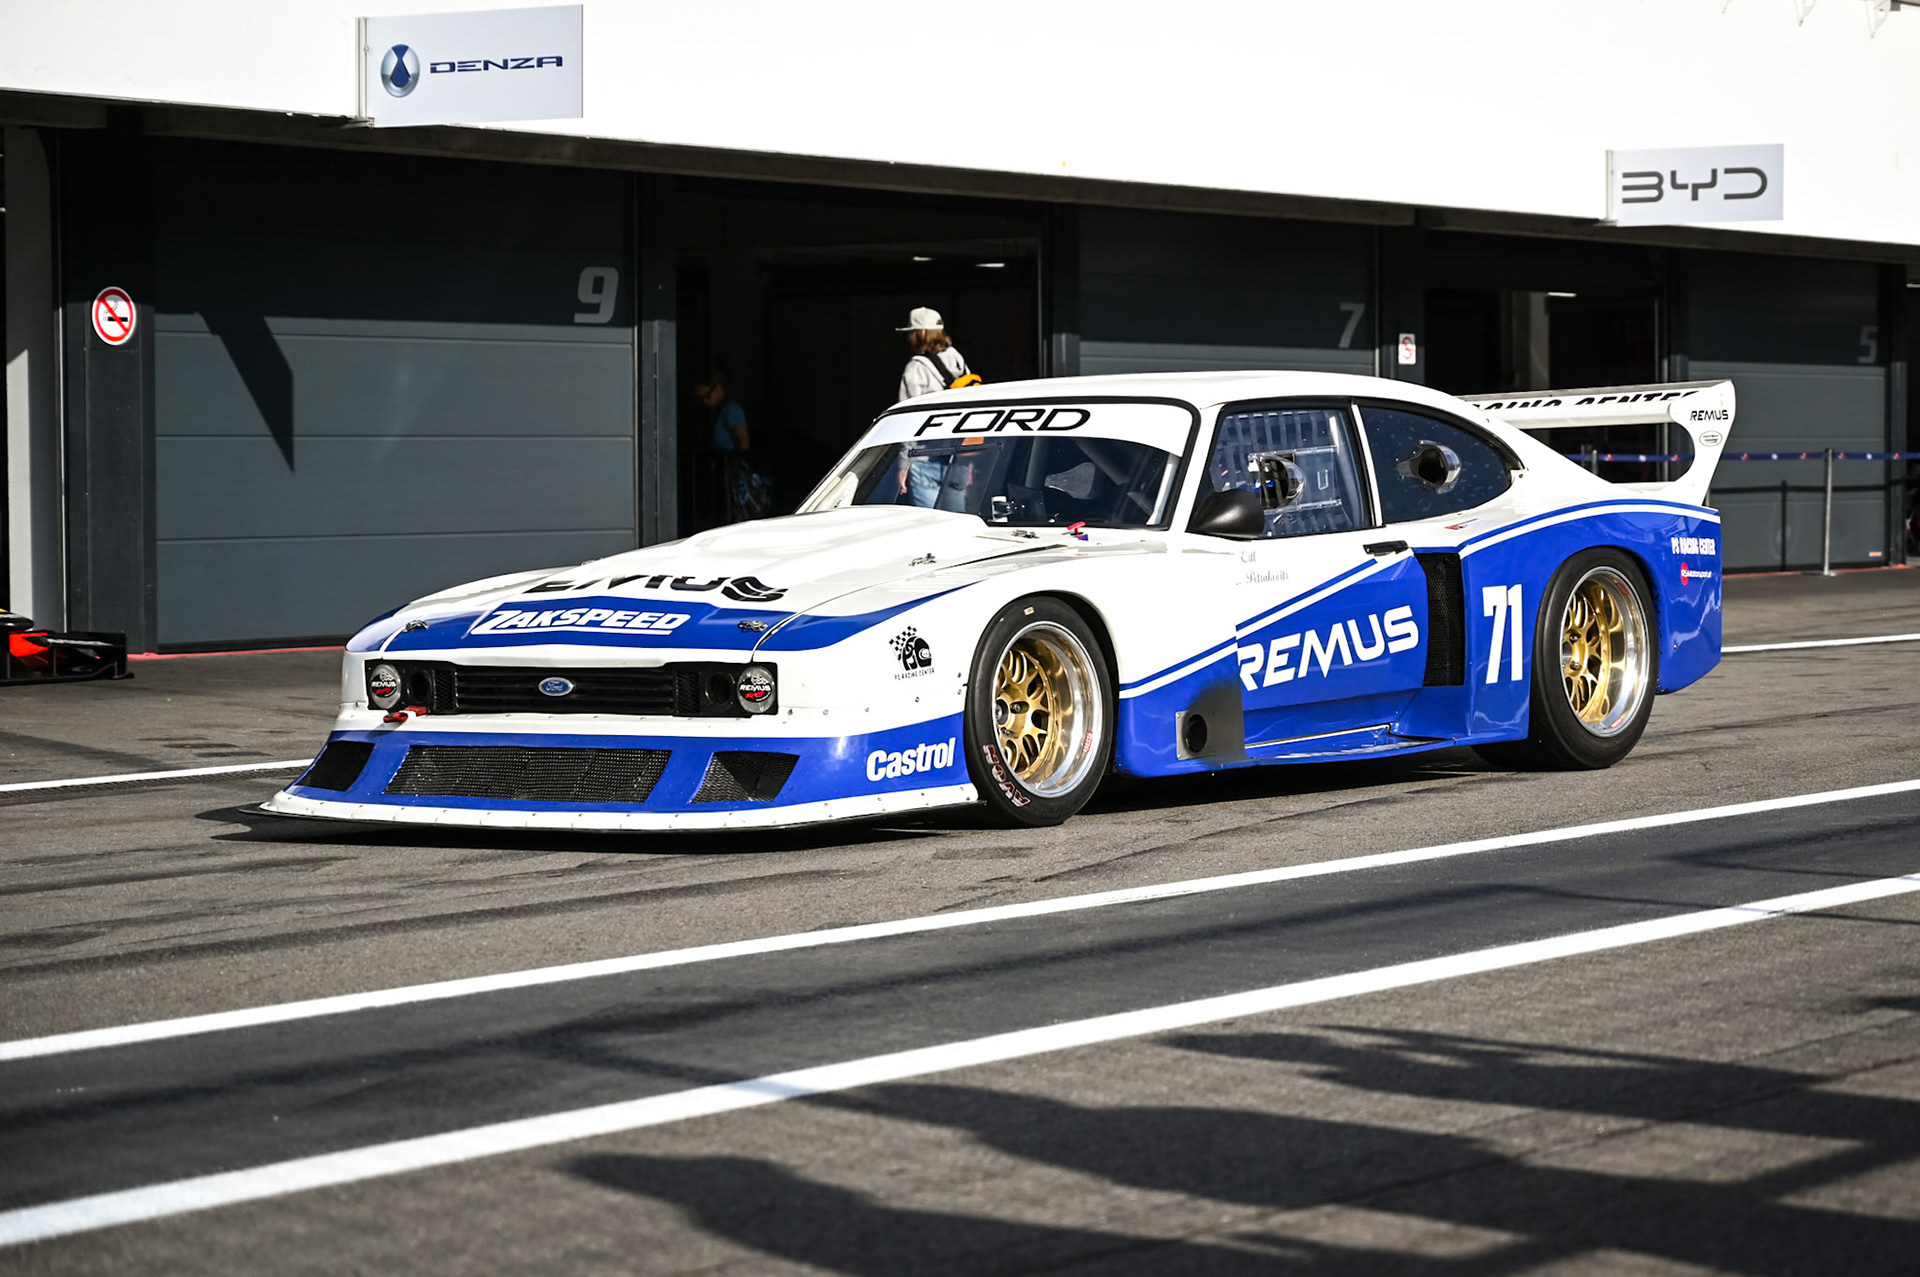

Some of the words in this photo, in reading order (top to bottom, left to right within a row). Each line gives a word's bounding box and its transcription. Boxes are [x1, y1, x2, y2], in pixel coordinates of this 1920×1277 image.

[430, 56, 563, 74] DENZA
[1622, 167, 1768, 204] BYD
[573, 266, 619, 324] 9
[1338, 302, 1365, 349] 7
[1857, 325, 1879, 364] 5
[913, 408, 1091, 437] FORD
[1690, 409, 1729, 421] REMUS
[470, 608, 691, 636] ZAKSPEED
[1482, 584, 1523, 685] 71
[1237, 605, 1419, 692] REMUS
[866, 736, 957, 782] Castrol
[982, 744, 1031, 807] AVON
